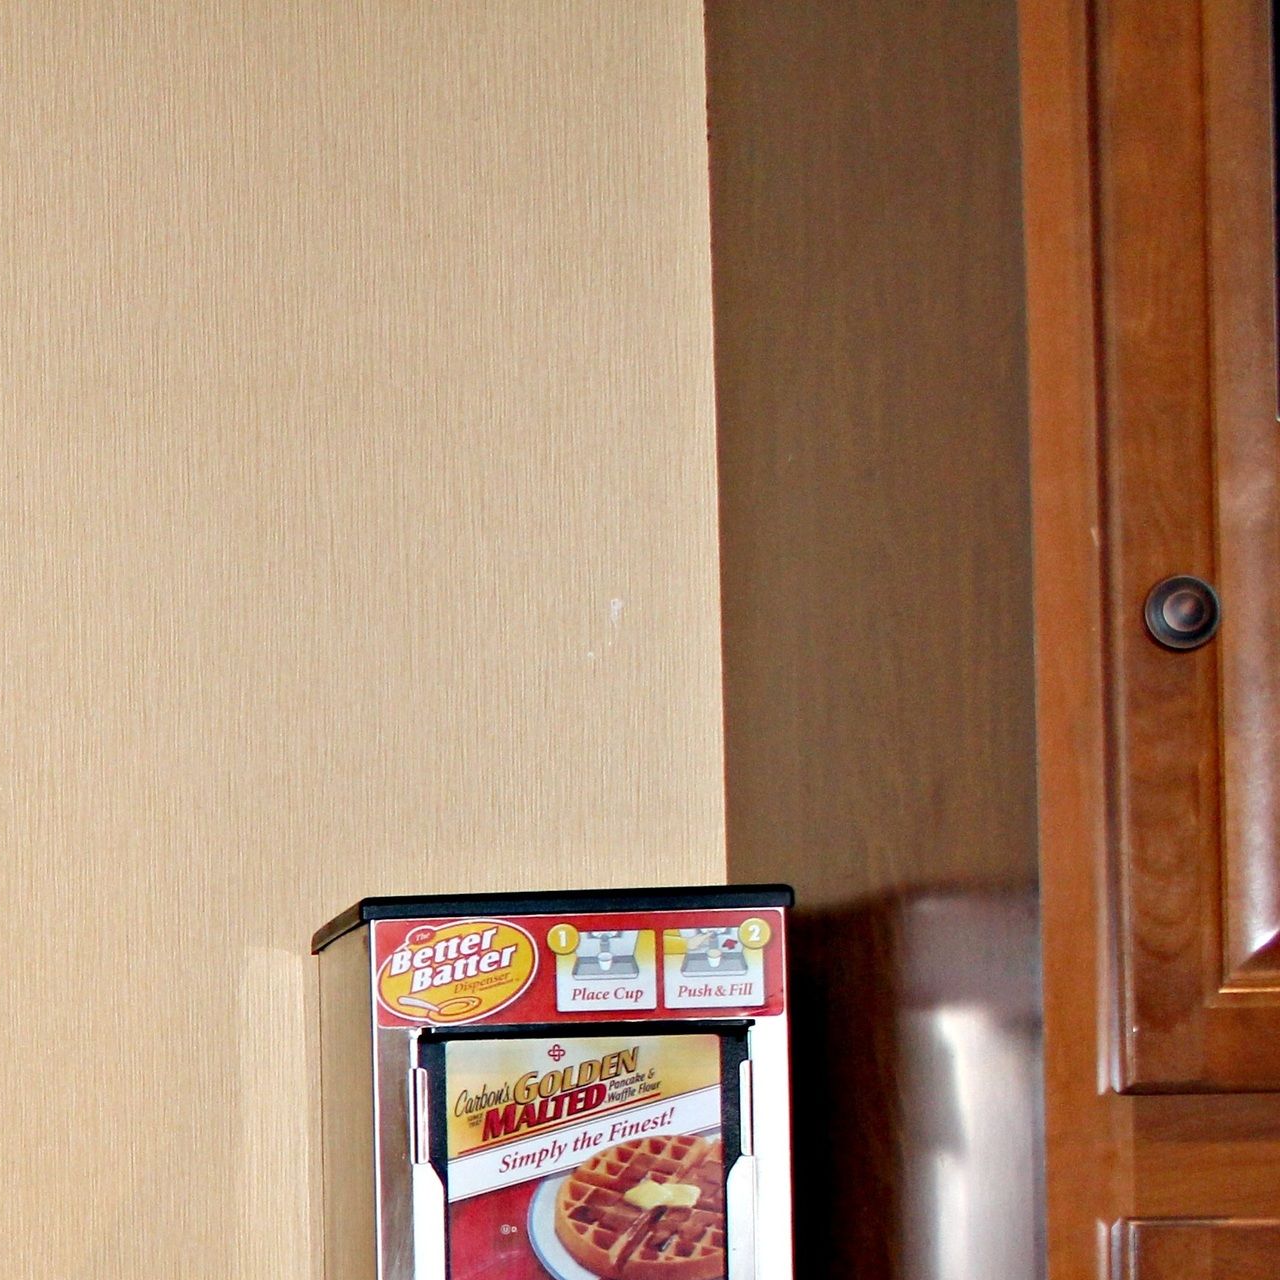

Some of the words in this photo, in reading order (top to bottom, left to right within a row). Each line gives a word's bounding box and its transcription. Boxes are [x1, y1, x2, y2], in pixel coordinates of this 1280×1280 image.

[415, 931, 431, 942] The
[558, 931, 567, 948] 1
[748, 925, 761, 942] 2
[390, 927, 498, 976] Better
[411, 945, 516, 994] Batter
[454, 972, 511, 994] Dispenser
[678, 984, 712, 998] Push
[714, 986, 724, 997] &
[729, 983, 753, 996] Fill
[572, 987, 609, 1001] Place
[614, 987, 643, 1002] Cup
[454, 1081, 510, 1118] Carbon's
[514, 1046, 639, 1105] GOLDEN
[609, 1073, 646, 1089] Pancake
[647, 1068, 656, 1078] &
[607, 1087, 637, 1103] Waffle
[639, 1080, 661, 1094] Flour
[482, 1083, 608, 1141] MALTED
[499, 1140, 568, 1173] Simply
[573, 1131, 603, 1151] the
[608, 1107, 675, 1142] Finest!
